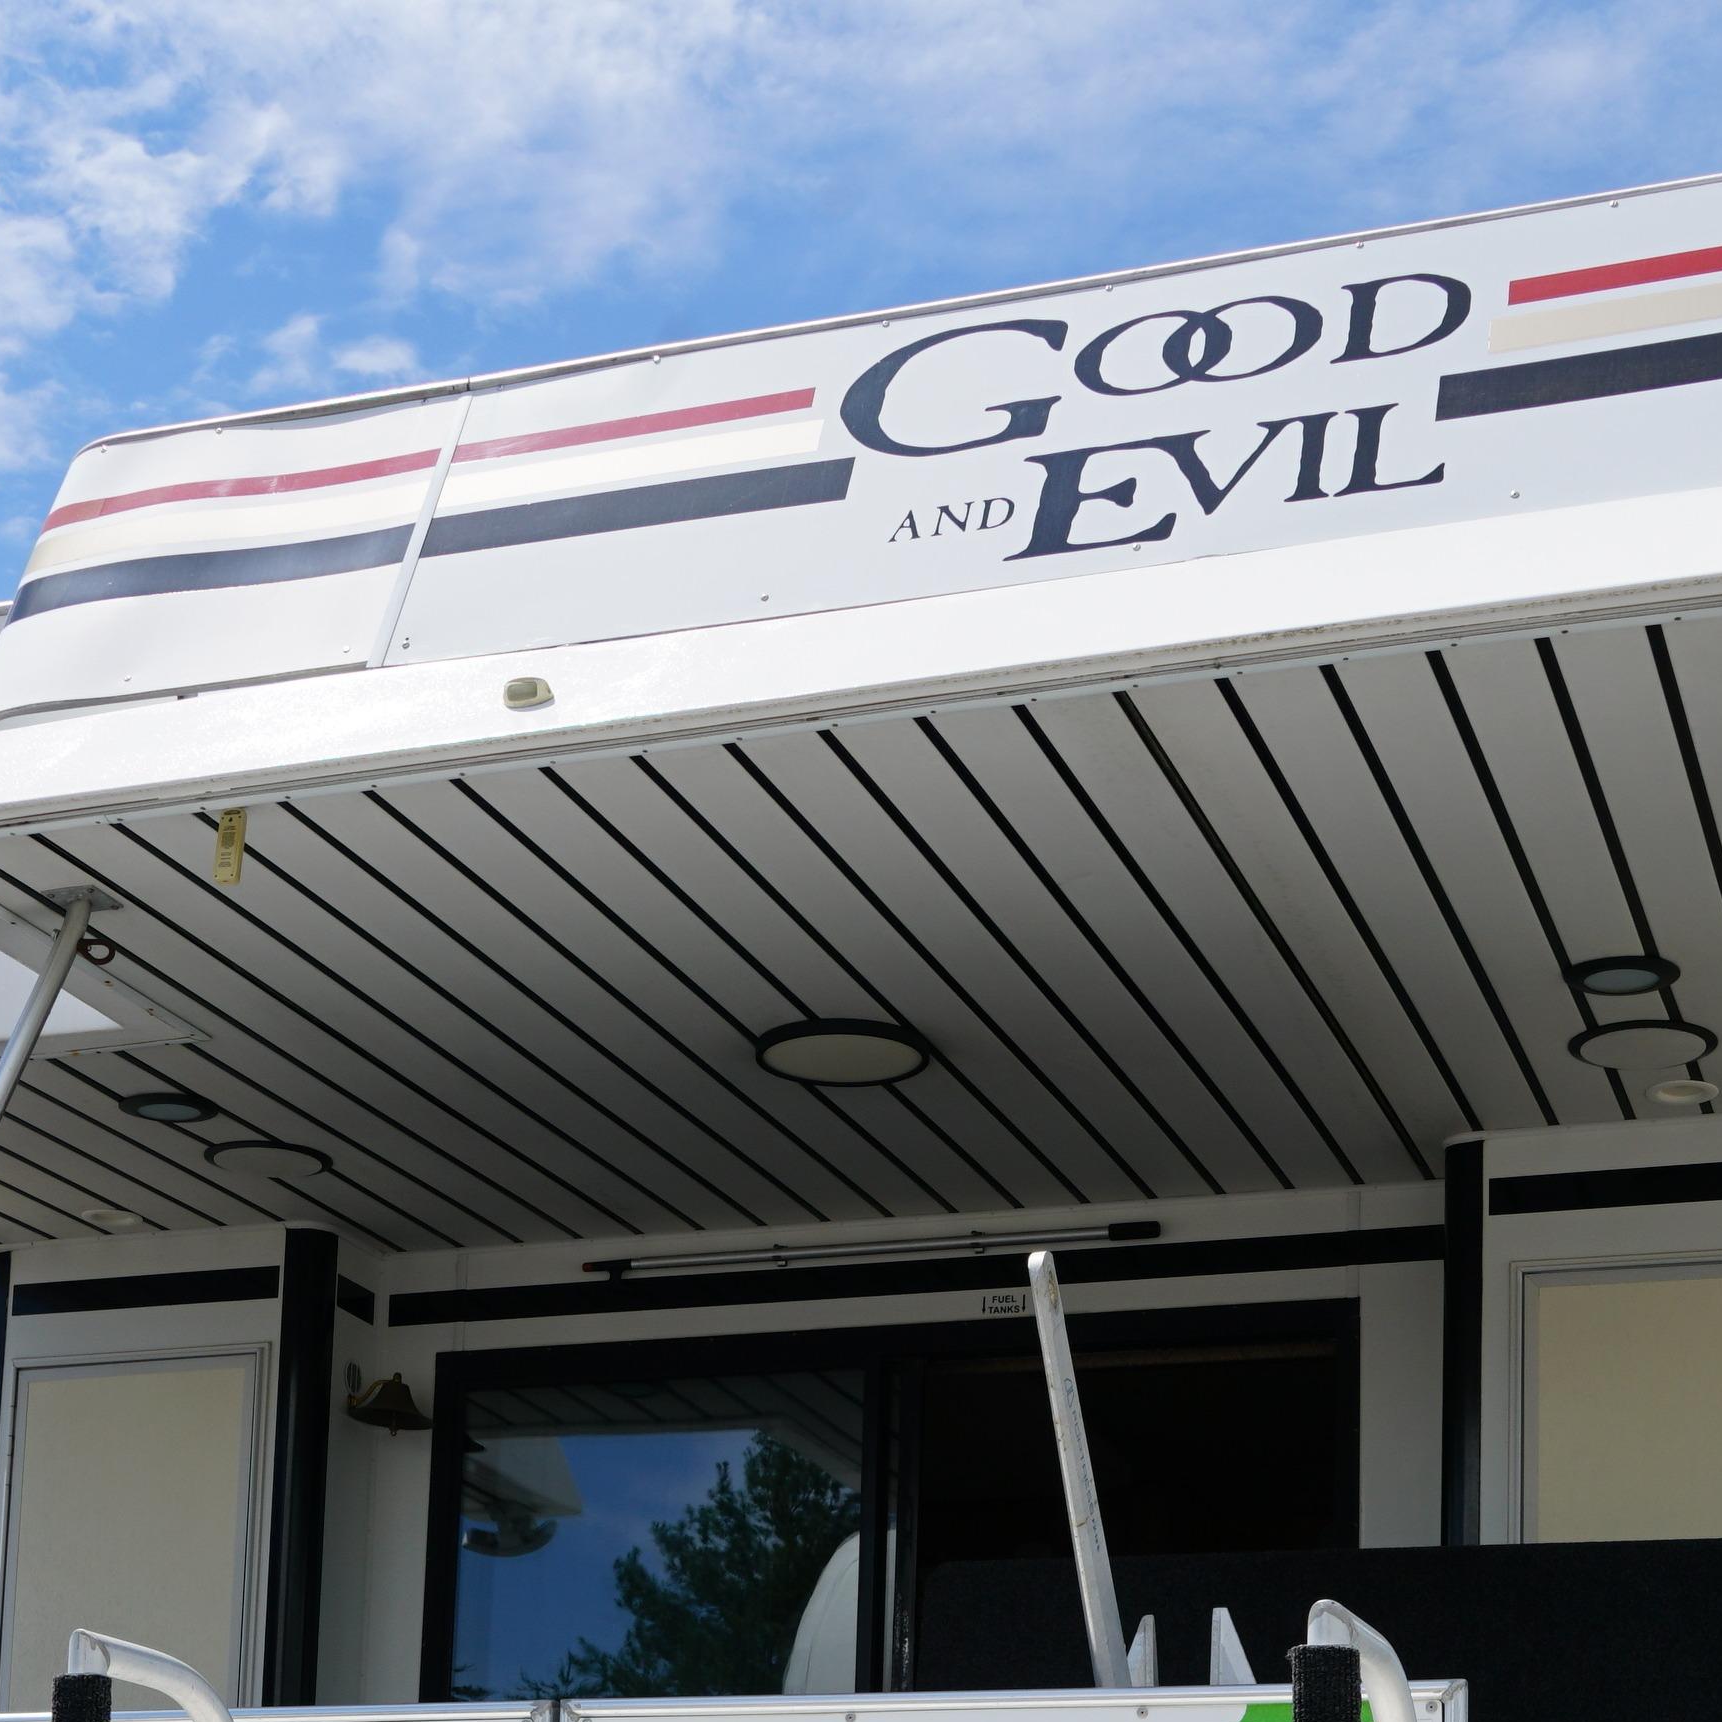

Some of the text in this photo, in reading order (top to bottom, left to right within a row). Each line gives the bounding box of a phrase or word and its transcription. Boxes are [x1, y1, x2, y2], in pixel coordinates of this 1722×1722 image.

[839, 273, 1472, 457] GOOD
[888, 403, 1446, 561] AND EVIL
[988, 1305, 1021, 1314] TANKS
[992, 1295, 1017, 1304] FUEL
